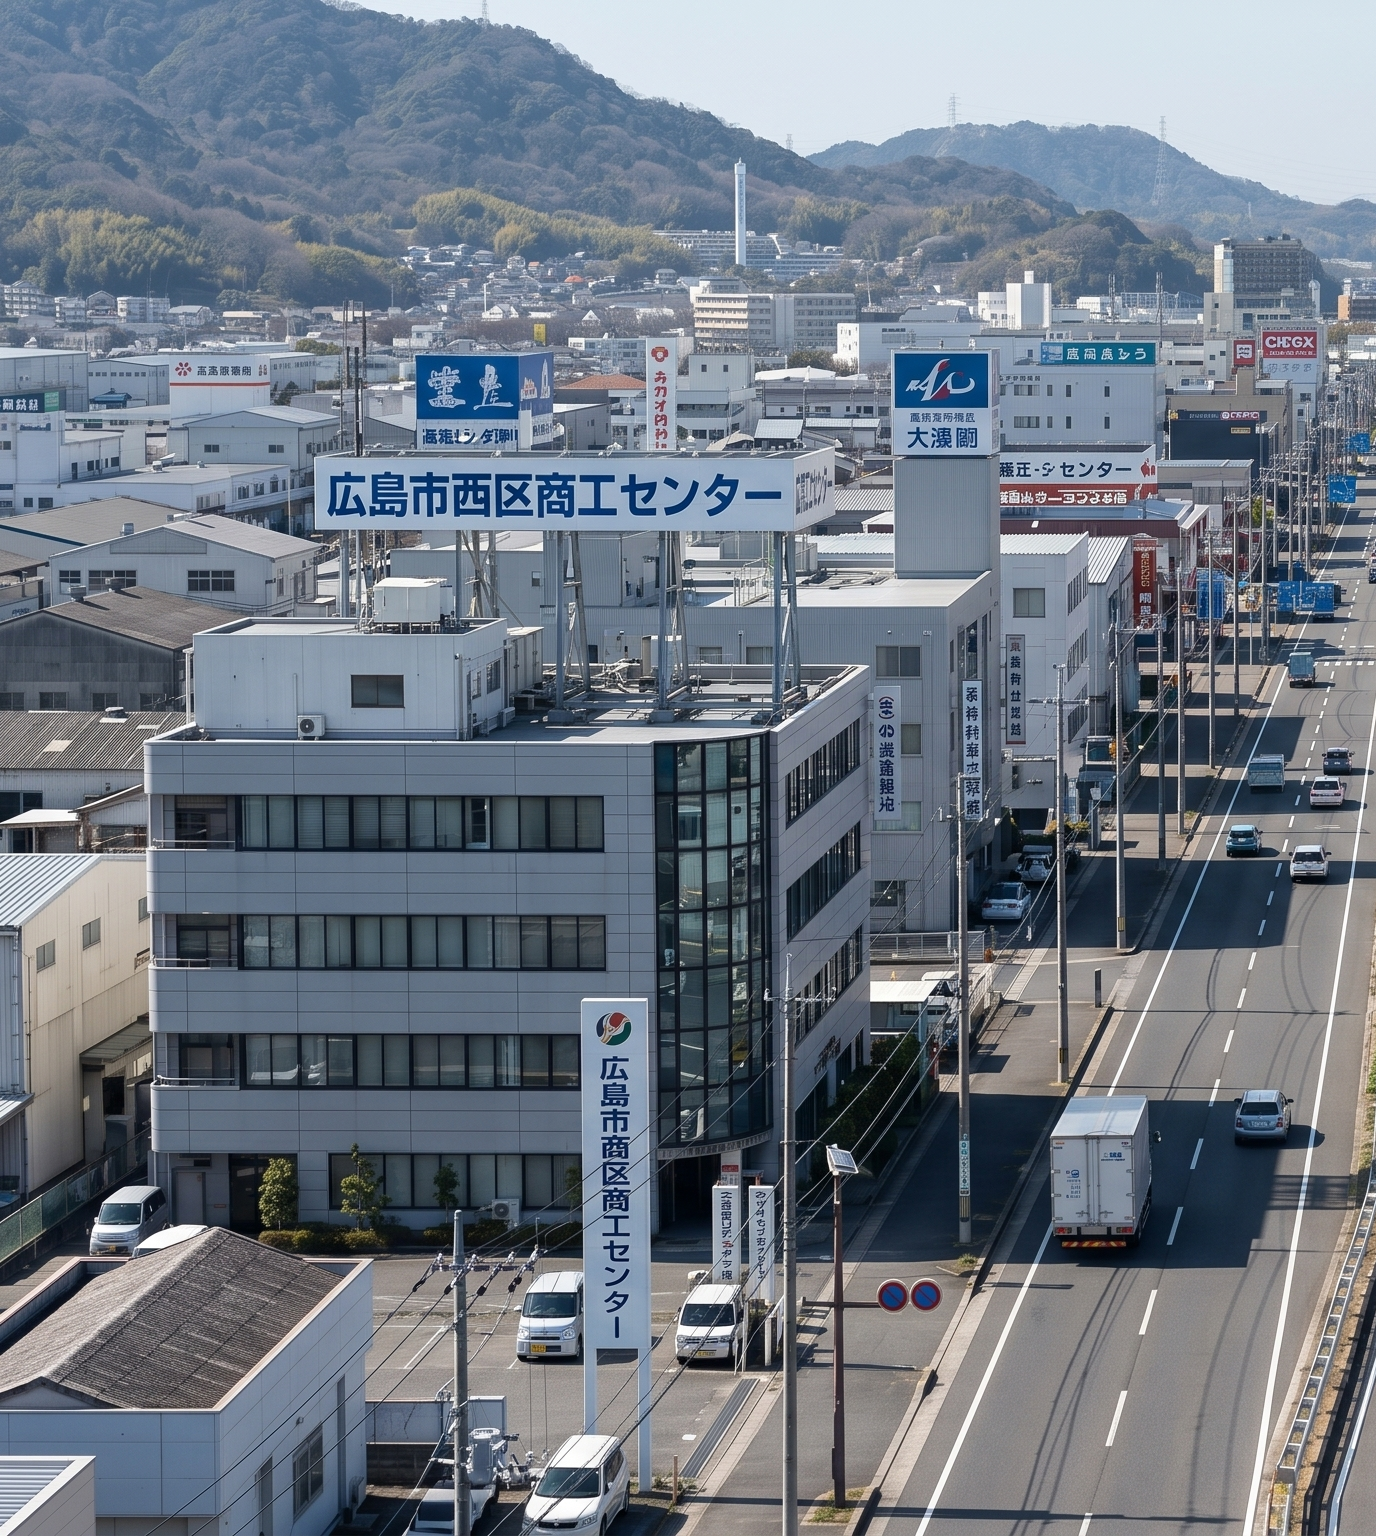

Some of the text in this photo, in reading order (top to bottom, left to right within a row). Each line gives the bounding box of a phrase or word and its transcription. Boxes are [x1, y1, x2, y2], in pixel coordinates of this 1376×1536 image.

[327, 471, 782, 518] 広島市西区商工センター
[600, 1055, 630, 1339] 広島市商区商工センター
